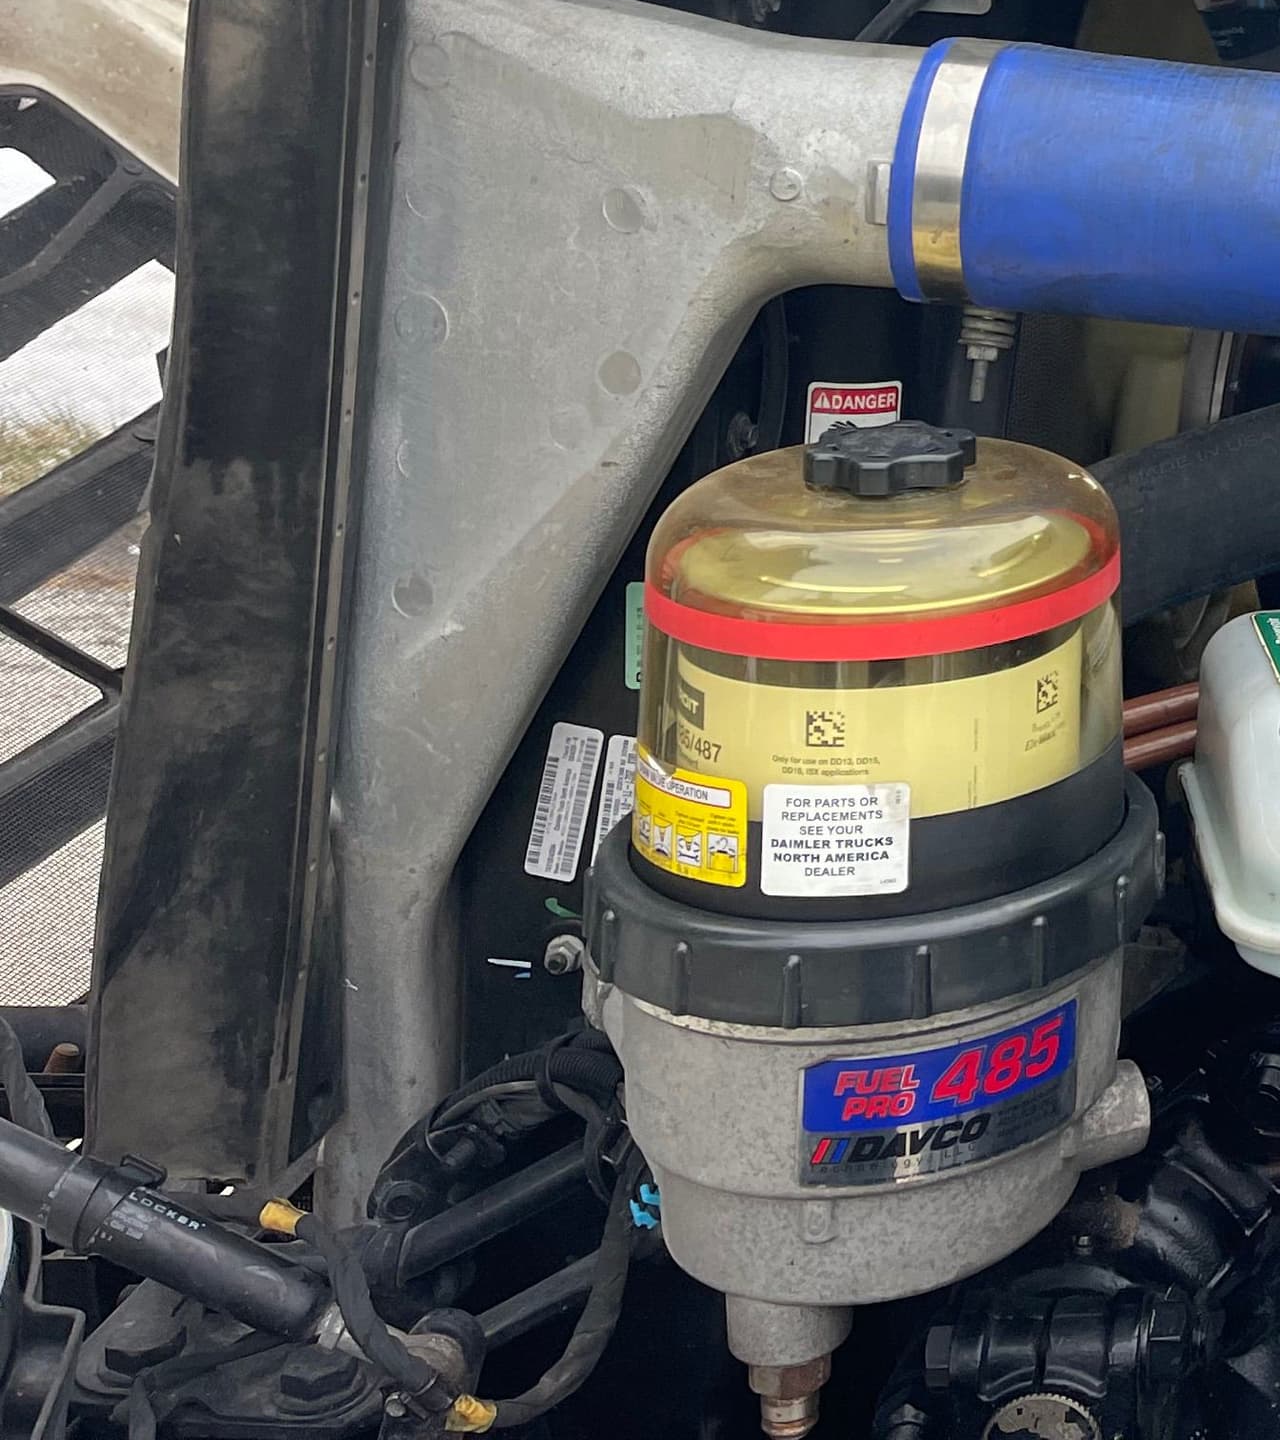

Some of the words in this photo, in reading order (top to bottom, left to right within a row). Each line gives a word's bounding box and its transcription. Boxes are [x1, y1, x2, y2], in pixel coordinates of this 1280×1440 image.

[831, 392, 897, 410] DANGER
[786, 797, 811, 808] FOR
[815, 798, 856, 808] PARTS
[860, 796, 879, 807] OR
[781, 810, 883, 822] REPLACEMENTS
[800, 825, 824, 836] SEE
[827, 824, 863, 835] YOUR
[771, 838, 831, 849] DAIMLER
[835, 836, 894, 848] TRUCKS
[773, 853, 820, 863] NORTH
[824, 850, 890, 863] AMERICA
[804, 866, 857, 877] DEALER
[929, 1014, 1064, 1107] 485
[834, 1064, 920, 1096] FUEL
[841, 1092, 916, 1121] PRO
[848, 1113, 992, 1163] DAVCO
